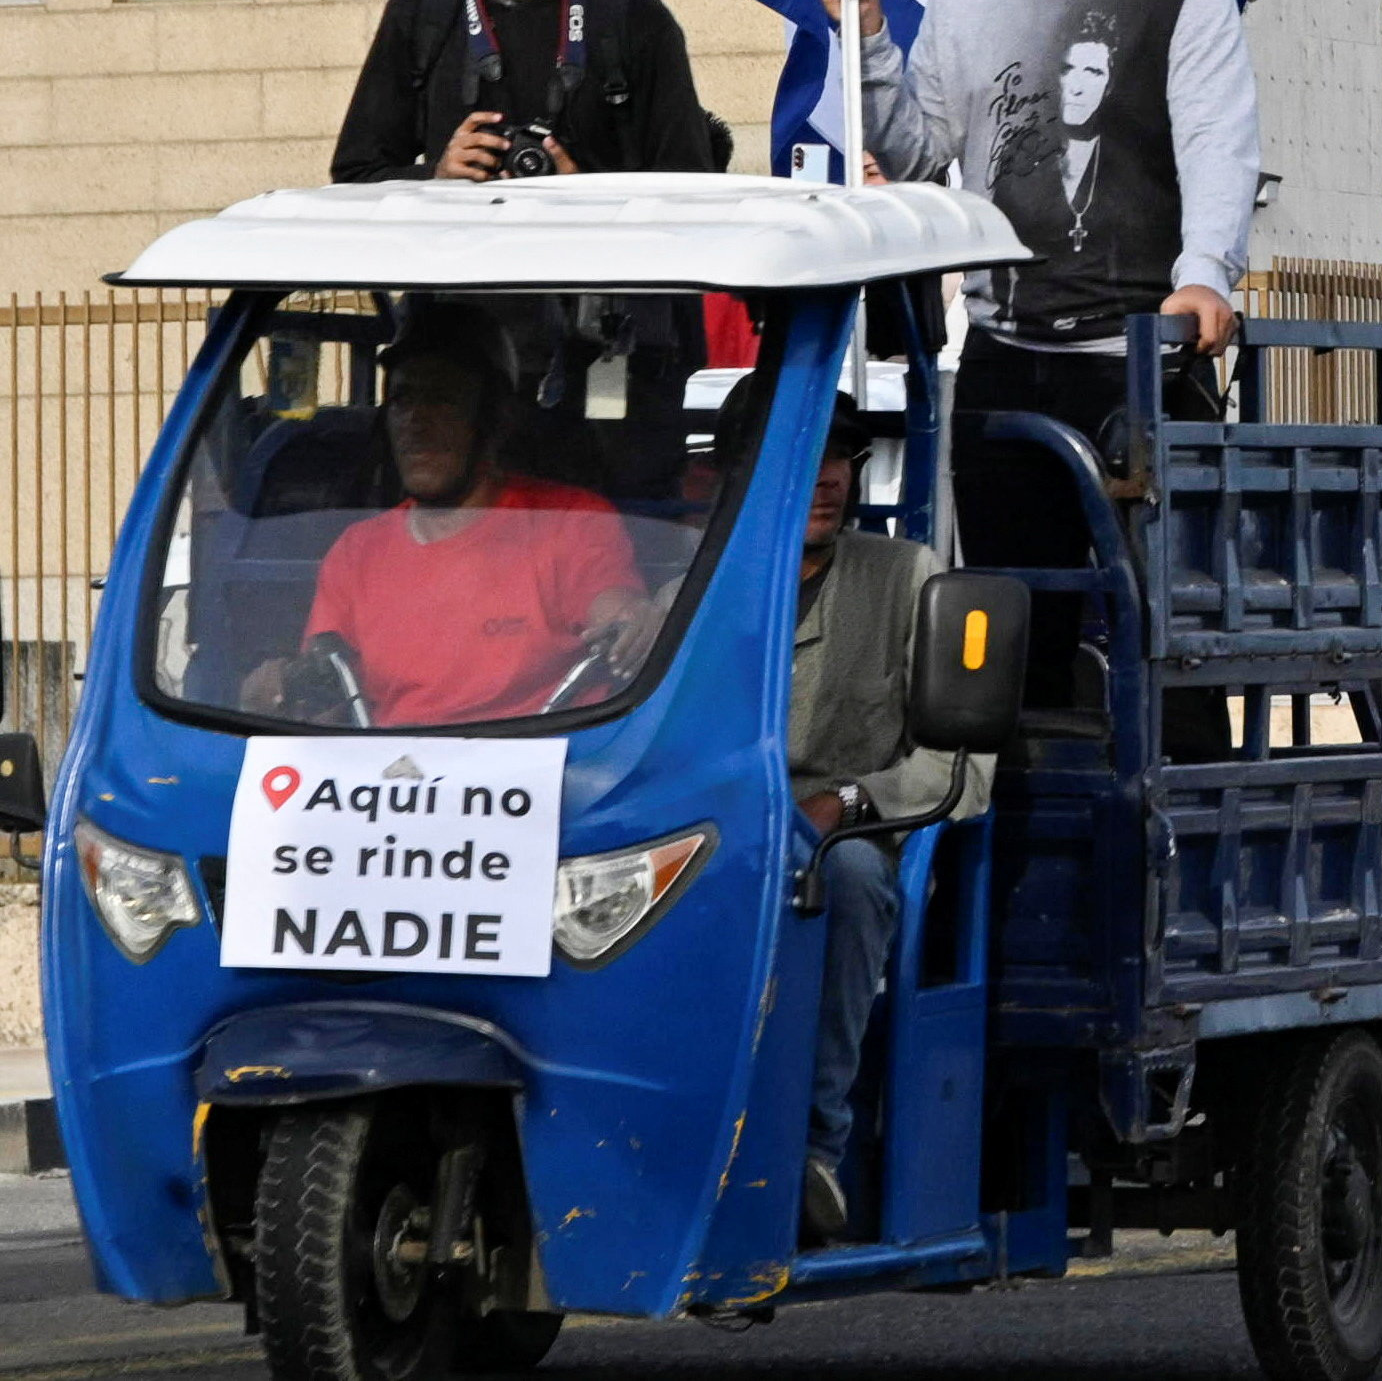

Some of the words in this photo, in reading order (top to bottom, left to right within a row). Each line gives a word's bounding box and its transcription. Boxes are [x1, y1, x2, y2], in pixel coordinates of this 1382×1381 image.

[569, 4, 585, 42] EOS
[303, 775, 447, 822] Aquí
[462, 785, 532, 817] no
[272, 845, 334, 875] se
[357, 834, 510, 880] rinde
[272, 907, 502, 960] NADIE
